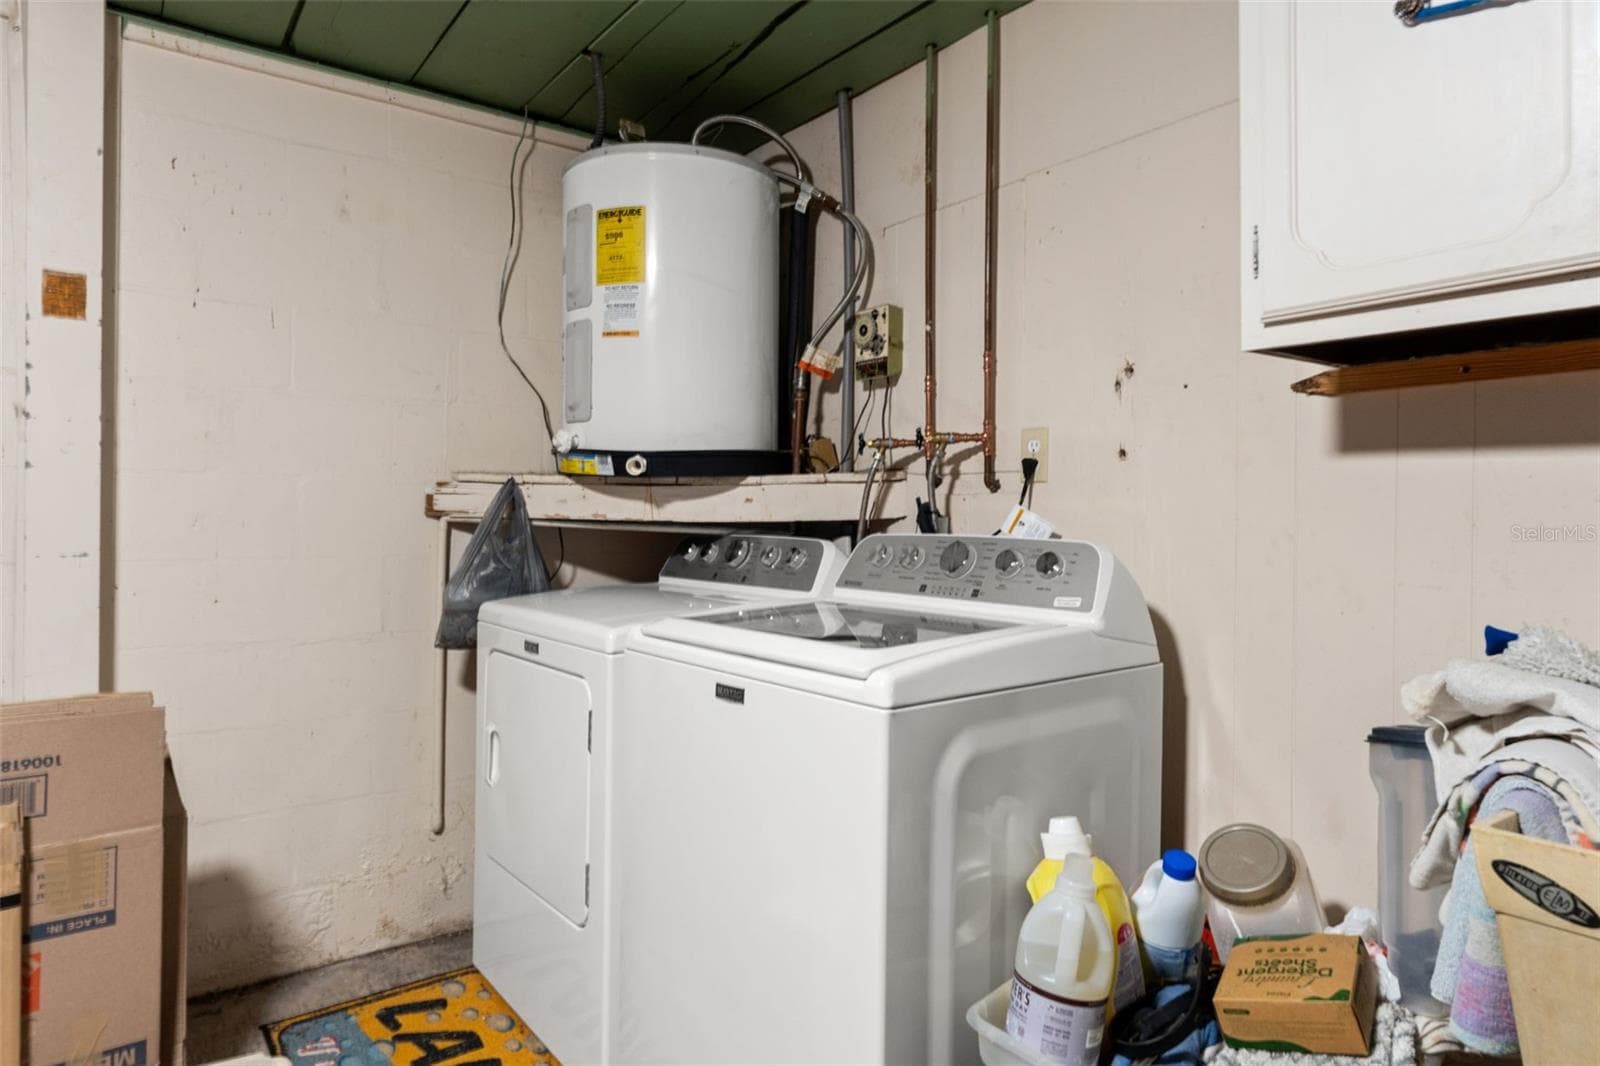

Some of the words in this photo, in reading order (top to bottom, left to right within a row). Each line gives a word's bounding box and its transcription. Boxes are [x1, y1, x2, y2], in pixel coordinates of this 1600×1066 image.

[66, 913, 107, 931] PLACE
[1254, 957, 1318, 969] Sheets
[1236, 965, 1334, 978] Detergent
